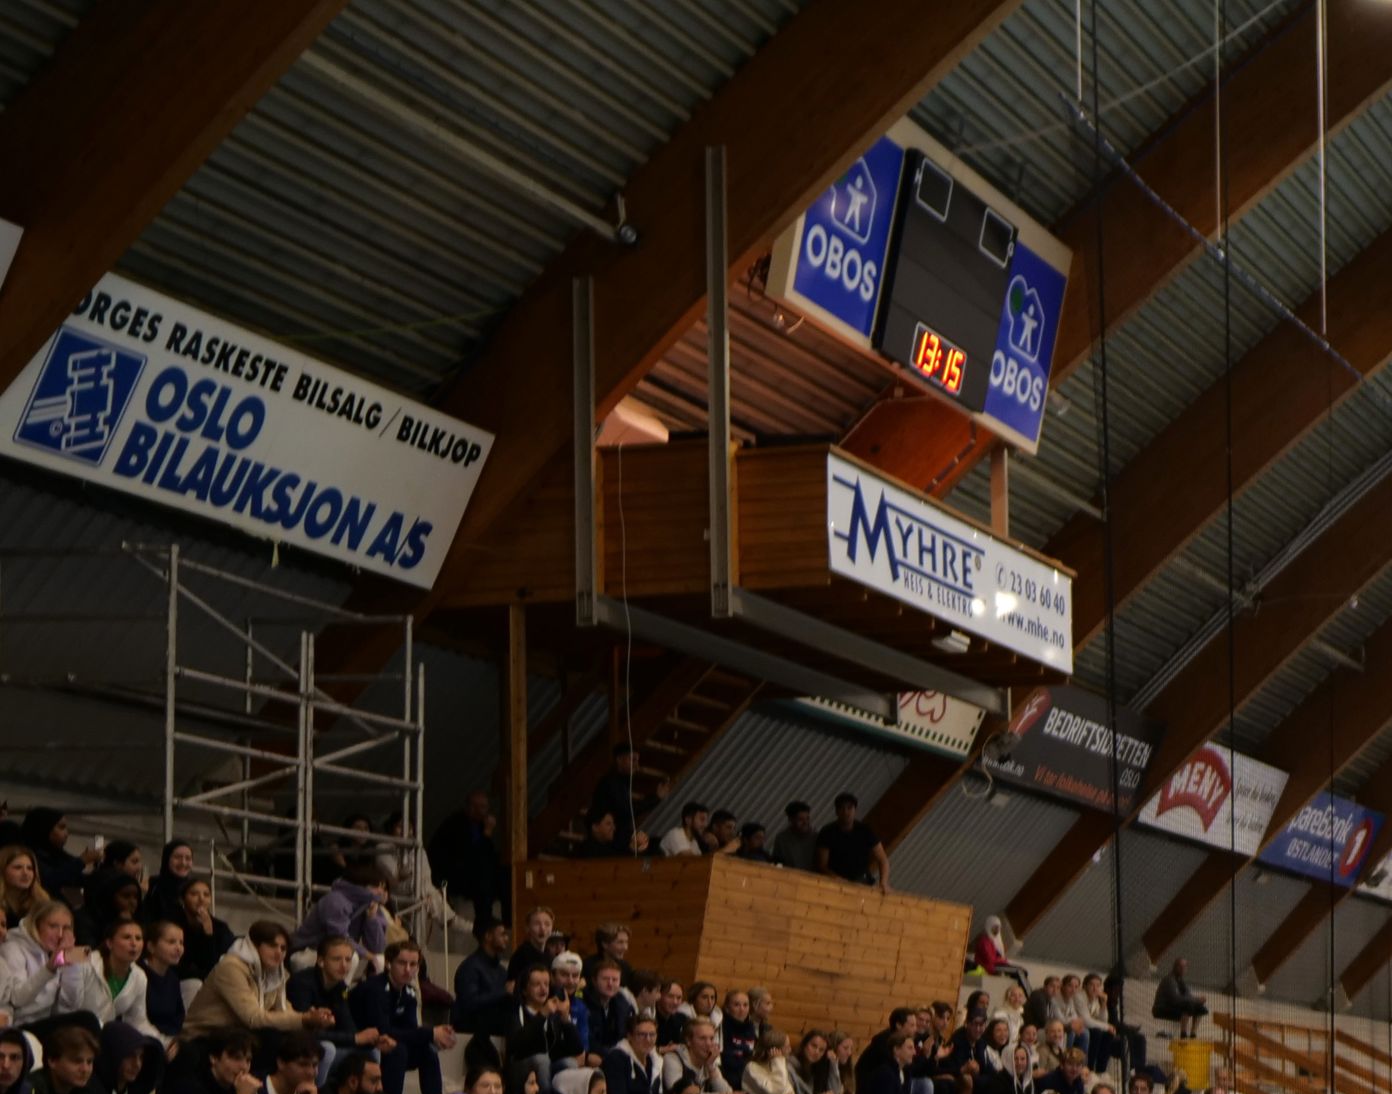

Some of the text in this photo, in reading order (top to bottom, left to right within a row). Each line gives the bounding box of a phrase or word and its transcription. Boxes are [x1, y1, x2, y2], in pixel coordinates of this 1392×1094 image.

[806, 224, 877, 301] OBOS
[166, 322, 290, 392] RASKESTE
[293, 372, 384, 430] BILSALG
[915, 331, 964, 392] 13:15
[990, 350, 1043, 412] OBOS
[145, 367, 266, 450] OSLO
[113, 422, 433, 570] BILAUKSJON A/S
[847, 475, 974, 590] MYHRE
[903, 569, 924, 597] HEIS
[1009, 571, 1065, 618] 23 03 60 40
[1001, 609, 1065, 649] ww.mhe.no
[1167, 760, 1224, 810] MENY
